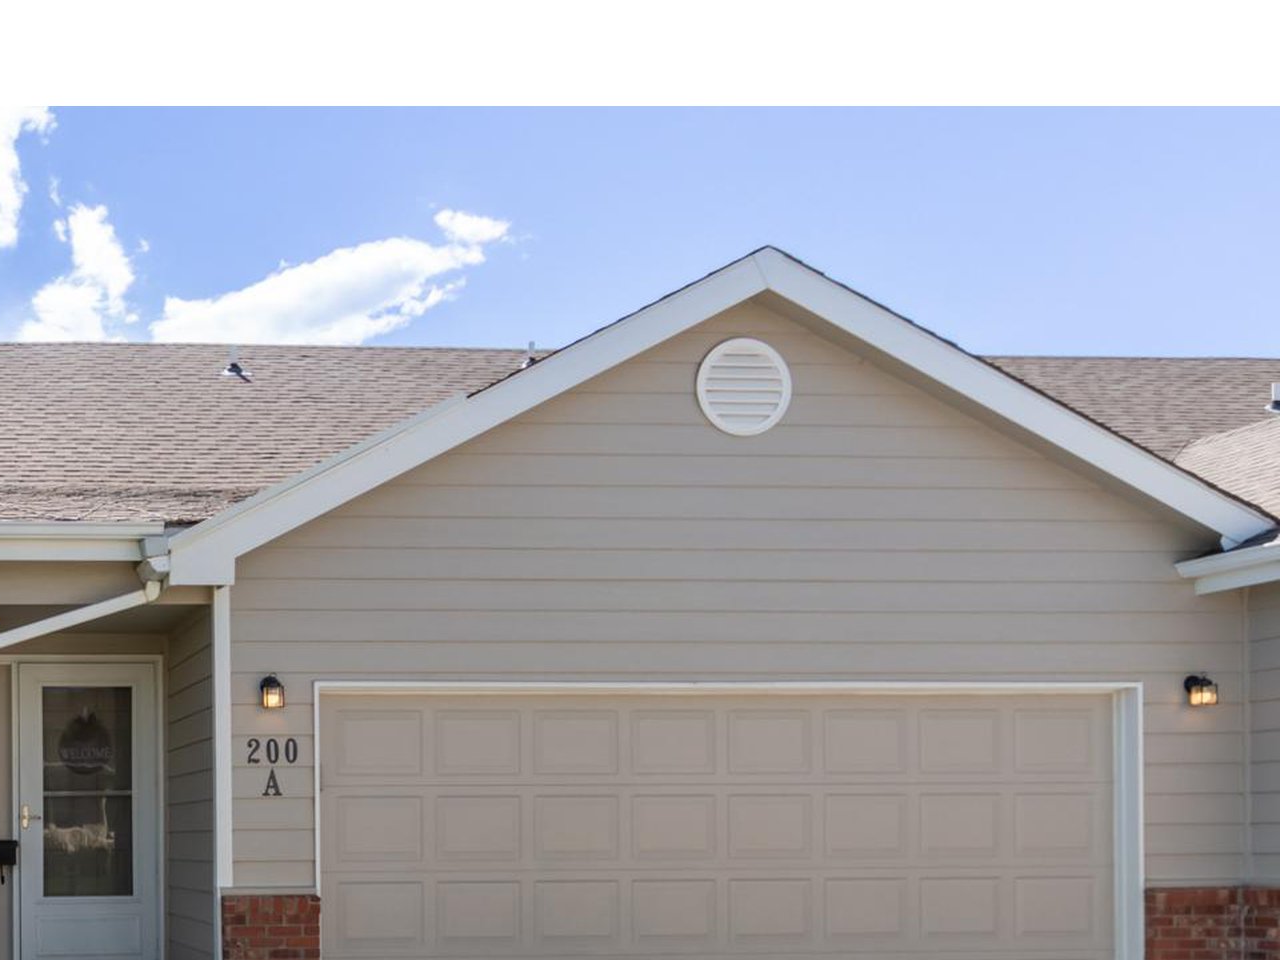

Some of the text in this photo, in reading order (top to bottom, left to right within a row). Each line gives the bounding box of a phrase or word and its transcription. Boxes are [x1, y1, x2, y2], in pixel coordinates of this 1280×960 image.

[59, 746, 113, 760] WELCOME
[247, 738, 298, 764] 200
[262, 768, 282, 796] A
